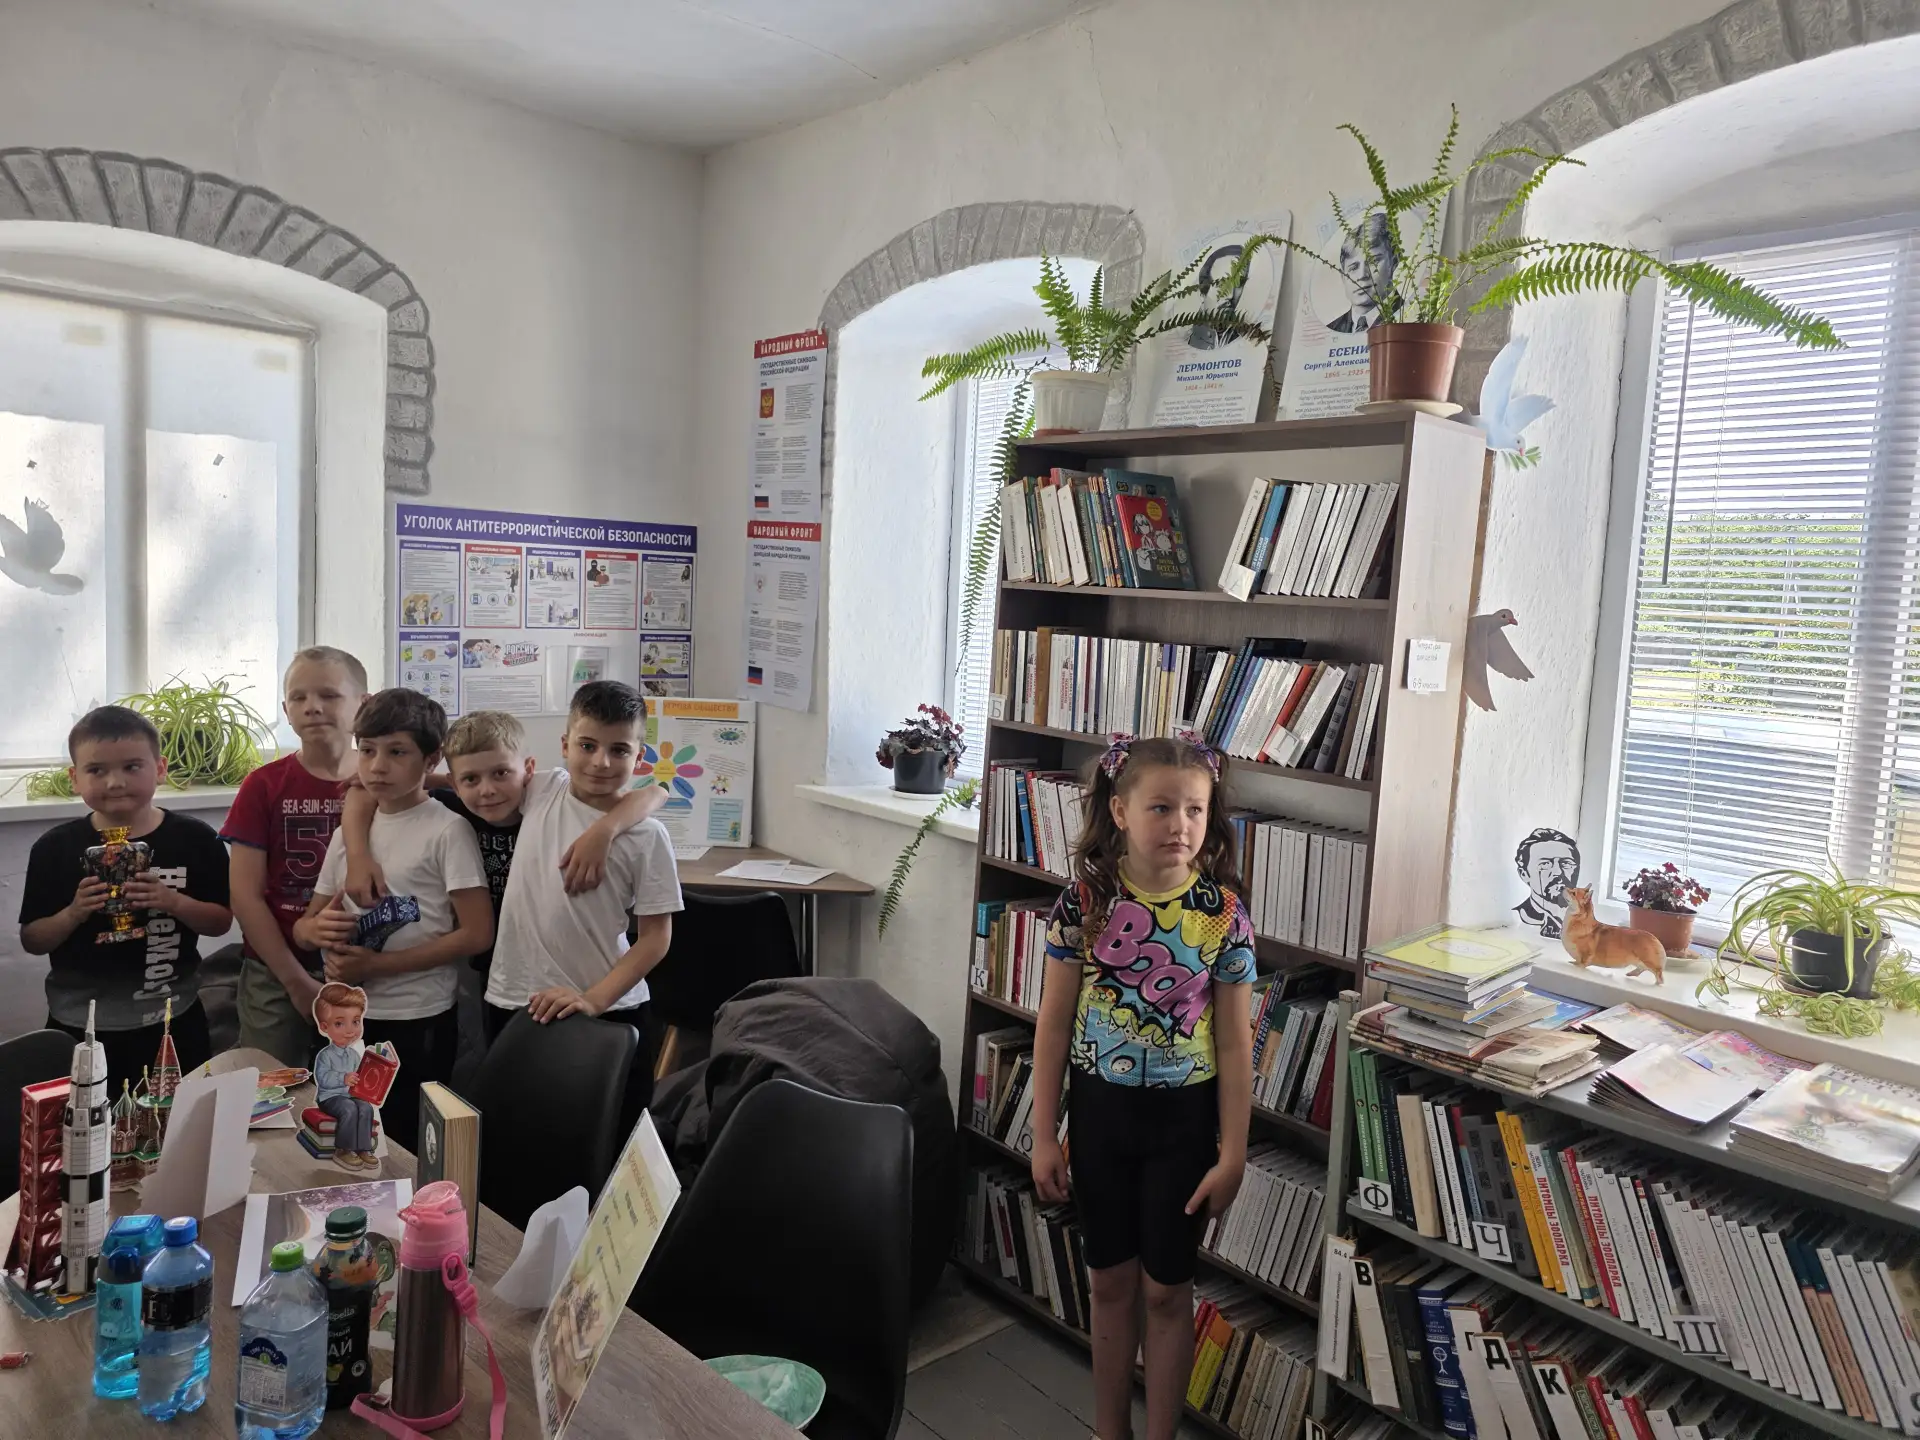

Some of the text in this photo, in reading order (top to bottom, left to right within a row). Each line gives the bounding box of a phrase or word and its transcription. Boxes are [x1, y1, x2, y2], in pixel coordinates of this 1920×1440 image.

[795, 336, 818, 348] ФРОНТ
[1328, 344, 1370, 358] ЕСЕНИ
[1176, 359, 1242, 374] ЛЕРМОНТОВ
[1206, 372, 1238, 380] Юрьевич
[1304, 358, 1370, 371] Сергей Алексан
[404, 515, 692, 546] УГОЛОК АНТИТЕРРОРИСТИЧЕСКОЙ БЕЗОПАСНОСТИ
[754, 526, 812, 538] НАРОДНЫЙ ФРОНТ
[664, 702, 737, 712] УГРОЗА ОБЩЕСТВУ
[992, 702, 1002, 719] Б
[284, 816, 329, 879] 5
[974, 967, 985, 988] К
[1092, 900, 1214, 1039] BOOM
[974, 1110, 986, 1133] Н
[1022, 1134, 1032, 1151] О
[1363, 1182, 1389, 1211] Ф
[1574, 1182, 1590, 1220] КАШТАНКА
[1537, 1176, 1570, 1268] ПИТОМЦЫ ЗООПАРКА
[1476, 1224, 1508, 1258] Ч
[1588, 1196, 1607, 1240] ПИТОМЦЫ
[1601, 1240, 1622, 1288] ЗООПАРКА
[1354, 1262, 1372, 1286] В
[328, 1337, 352, 1358] АЙ
[1672, 1320, 1727, 1356] Ш
[1483, 1338, 1510, 1370] Д
[1538, 1368, 1566, 1396] К
